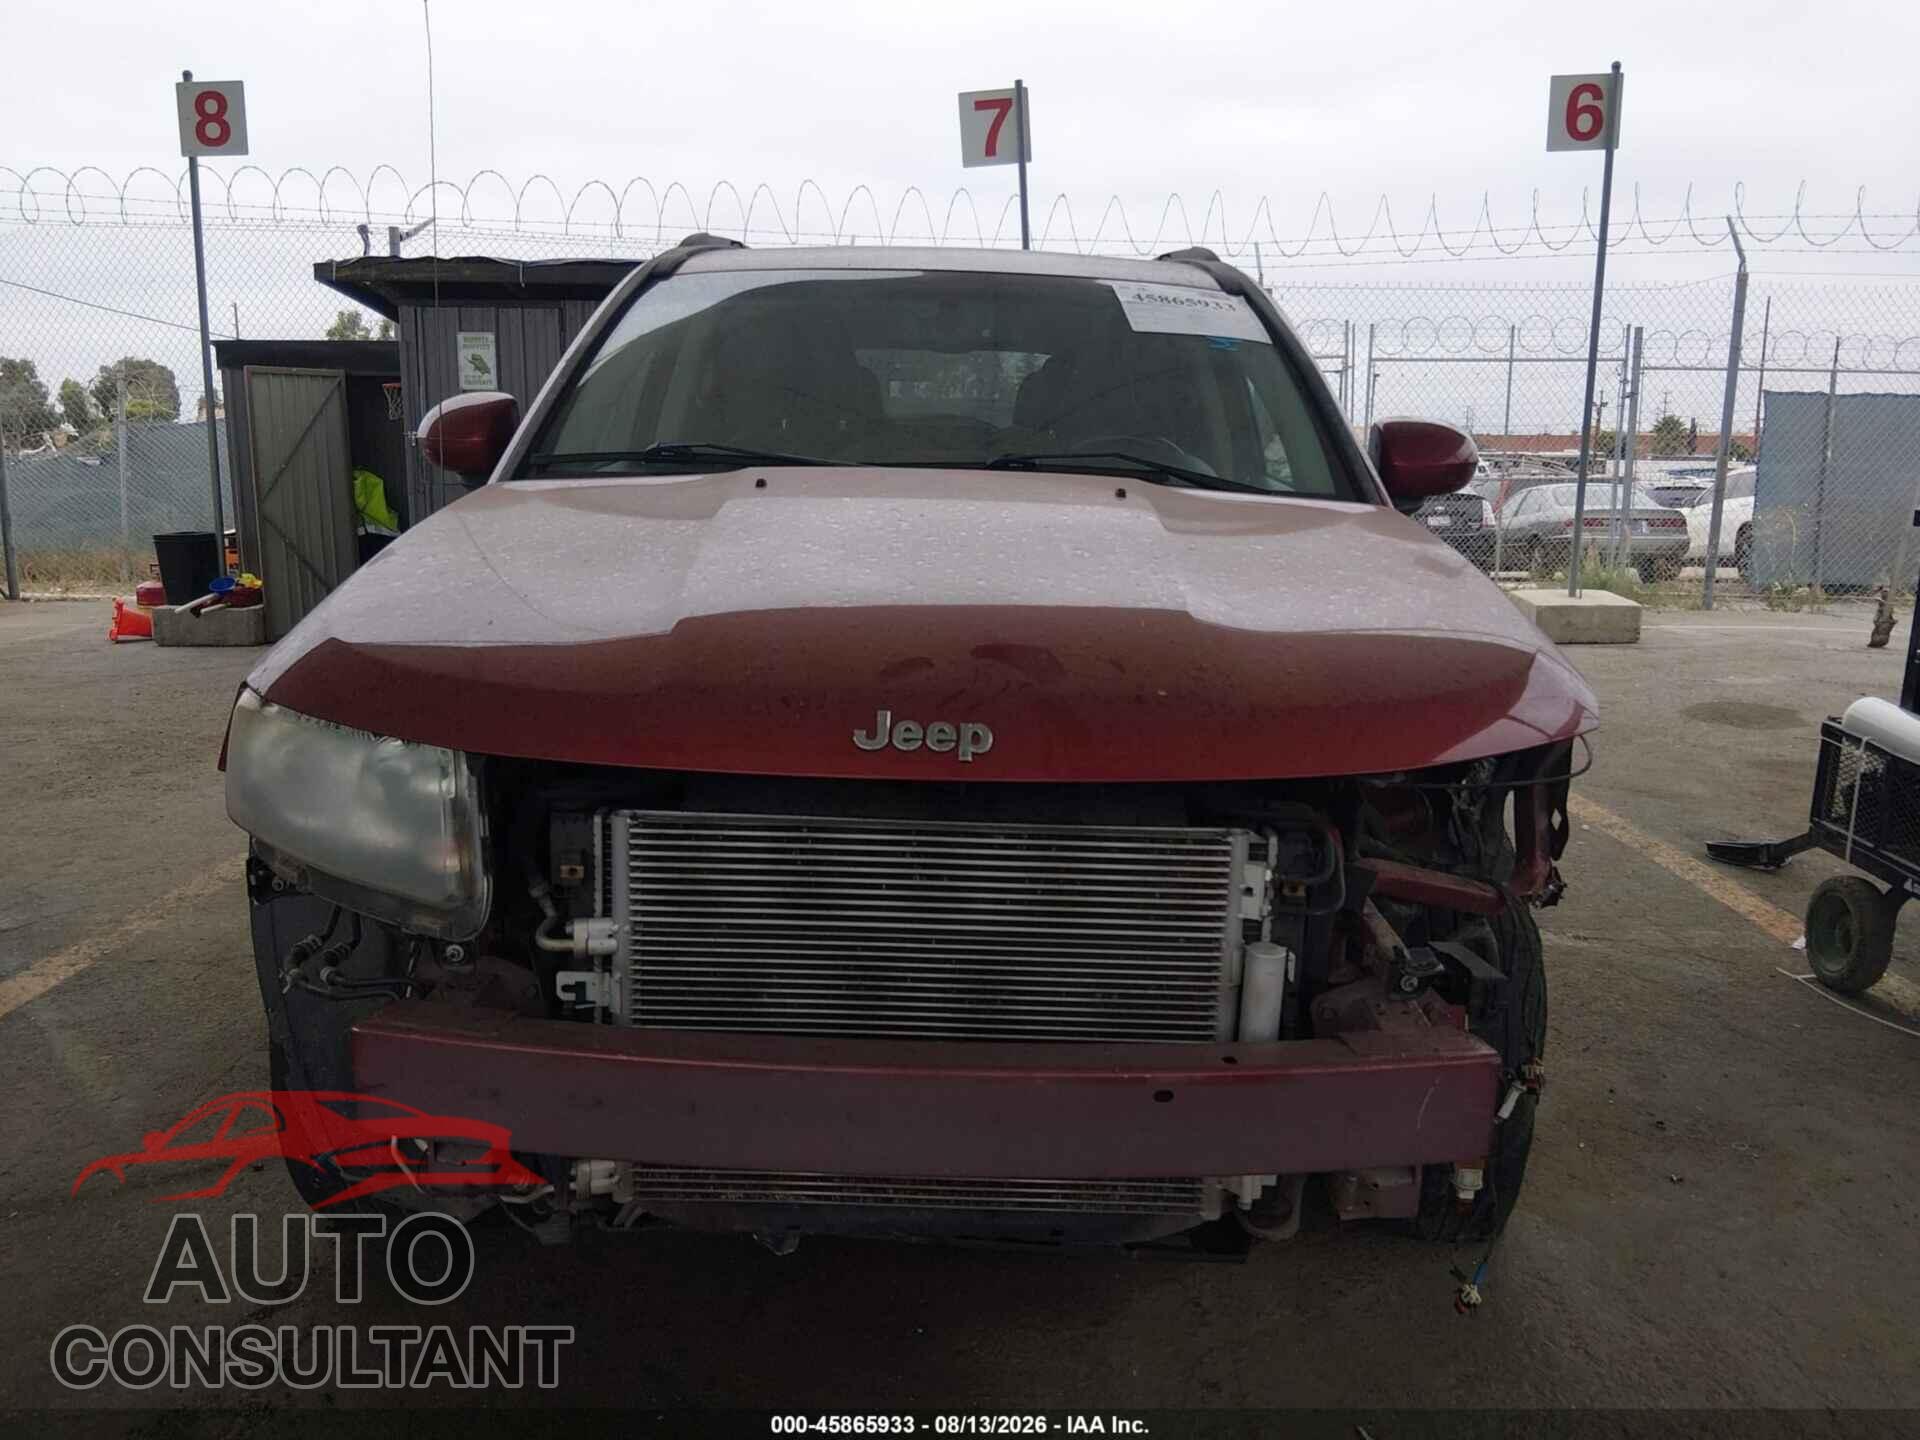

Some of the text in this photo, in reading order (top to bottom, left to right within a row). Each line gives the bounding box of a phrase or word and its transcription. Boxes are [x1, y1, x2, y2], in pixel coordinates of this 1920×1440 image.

[194, 90, 231, 147] 8
[974, 98, 1013, 157] 7
[1566, 83, 1604, 141] 6
[1132, 292, 1237, 313] 45865933
[853, 710, 993, 762] Jeep
